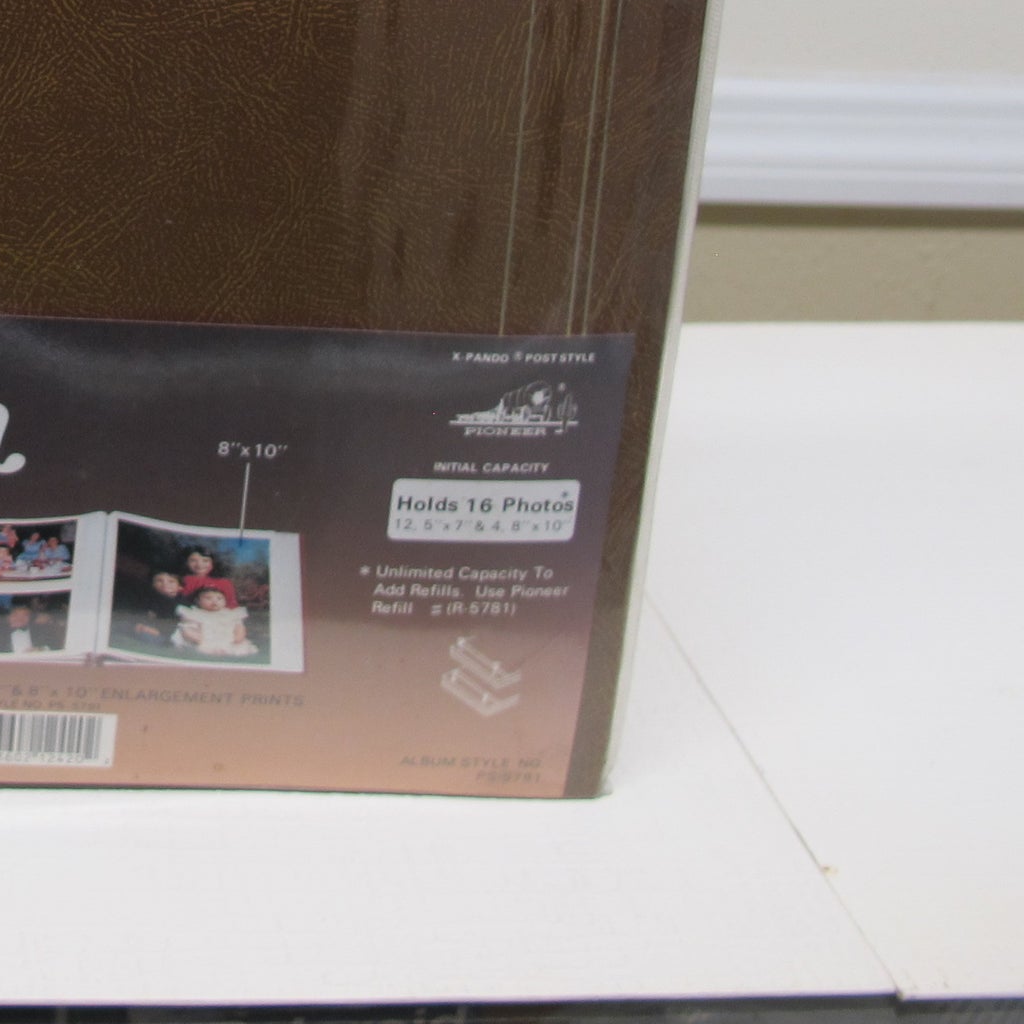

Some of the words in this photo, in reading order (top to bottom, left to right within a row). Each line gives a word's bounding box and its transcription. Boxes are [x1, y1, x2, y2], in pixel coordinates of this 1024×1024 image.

[525, 352, 558, 364] POST
[559, 352, 596, 364] STYLE
[464, 426, 546, 436] PIONEER
[433, 461, 477, 473] INITIAL
[482, 462, 550, 474] CAPACITY
[397, 495, 458, 512] Holds
[466, 497, 493, 514] 16
[474, 519, 484, 532] &
[376, 564, 454, 580] Unlimited
[458, 565, 527, 581] Capacity
[533, 564, 554, 580] To
[373, 583, 405, 597] Add
[475, 585, 506, 598] Use
[511, 584, 569, 599] Pioneer
[372, 601, 413, 615] Refill
[101, 687, 233, 705] ENLARGEMENT
[240, 692, 304, 707] PRINTS
